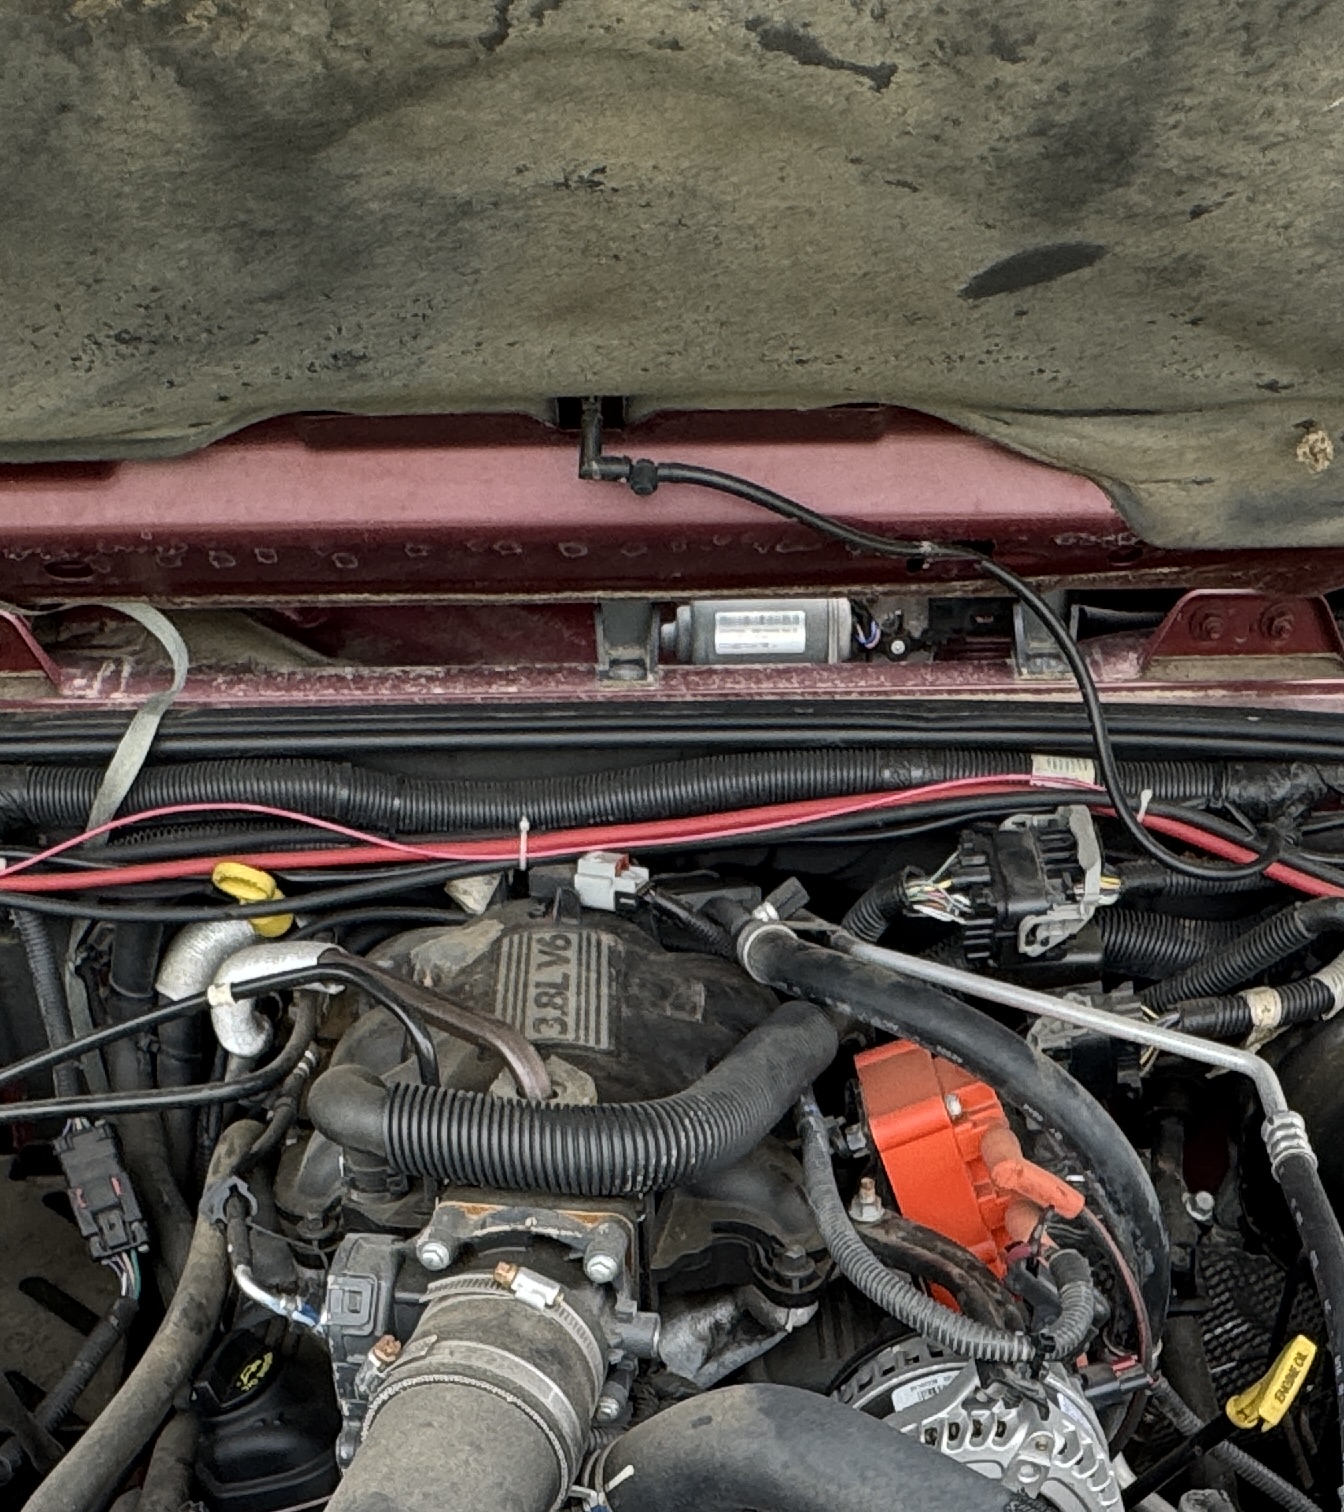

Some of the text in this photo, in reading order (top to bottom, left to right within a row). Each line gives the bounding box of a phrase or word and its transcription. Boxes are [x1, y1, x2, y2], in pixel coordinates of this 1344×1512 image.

[532, 933, 572, 1035] 3.8L V6
[1274, 1351, 1309, 1405] ENGINE OIL
